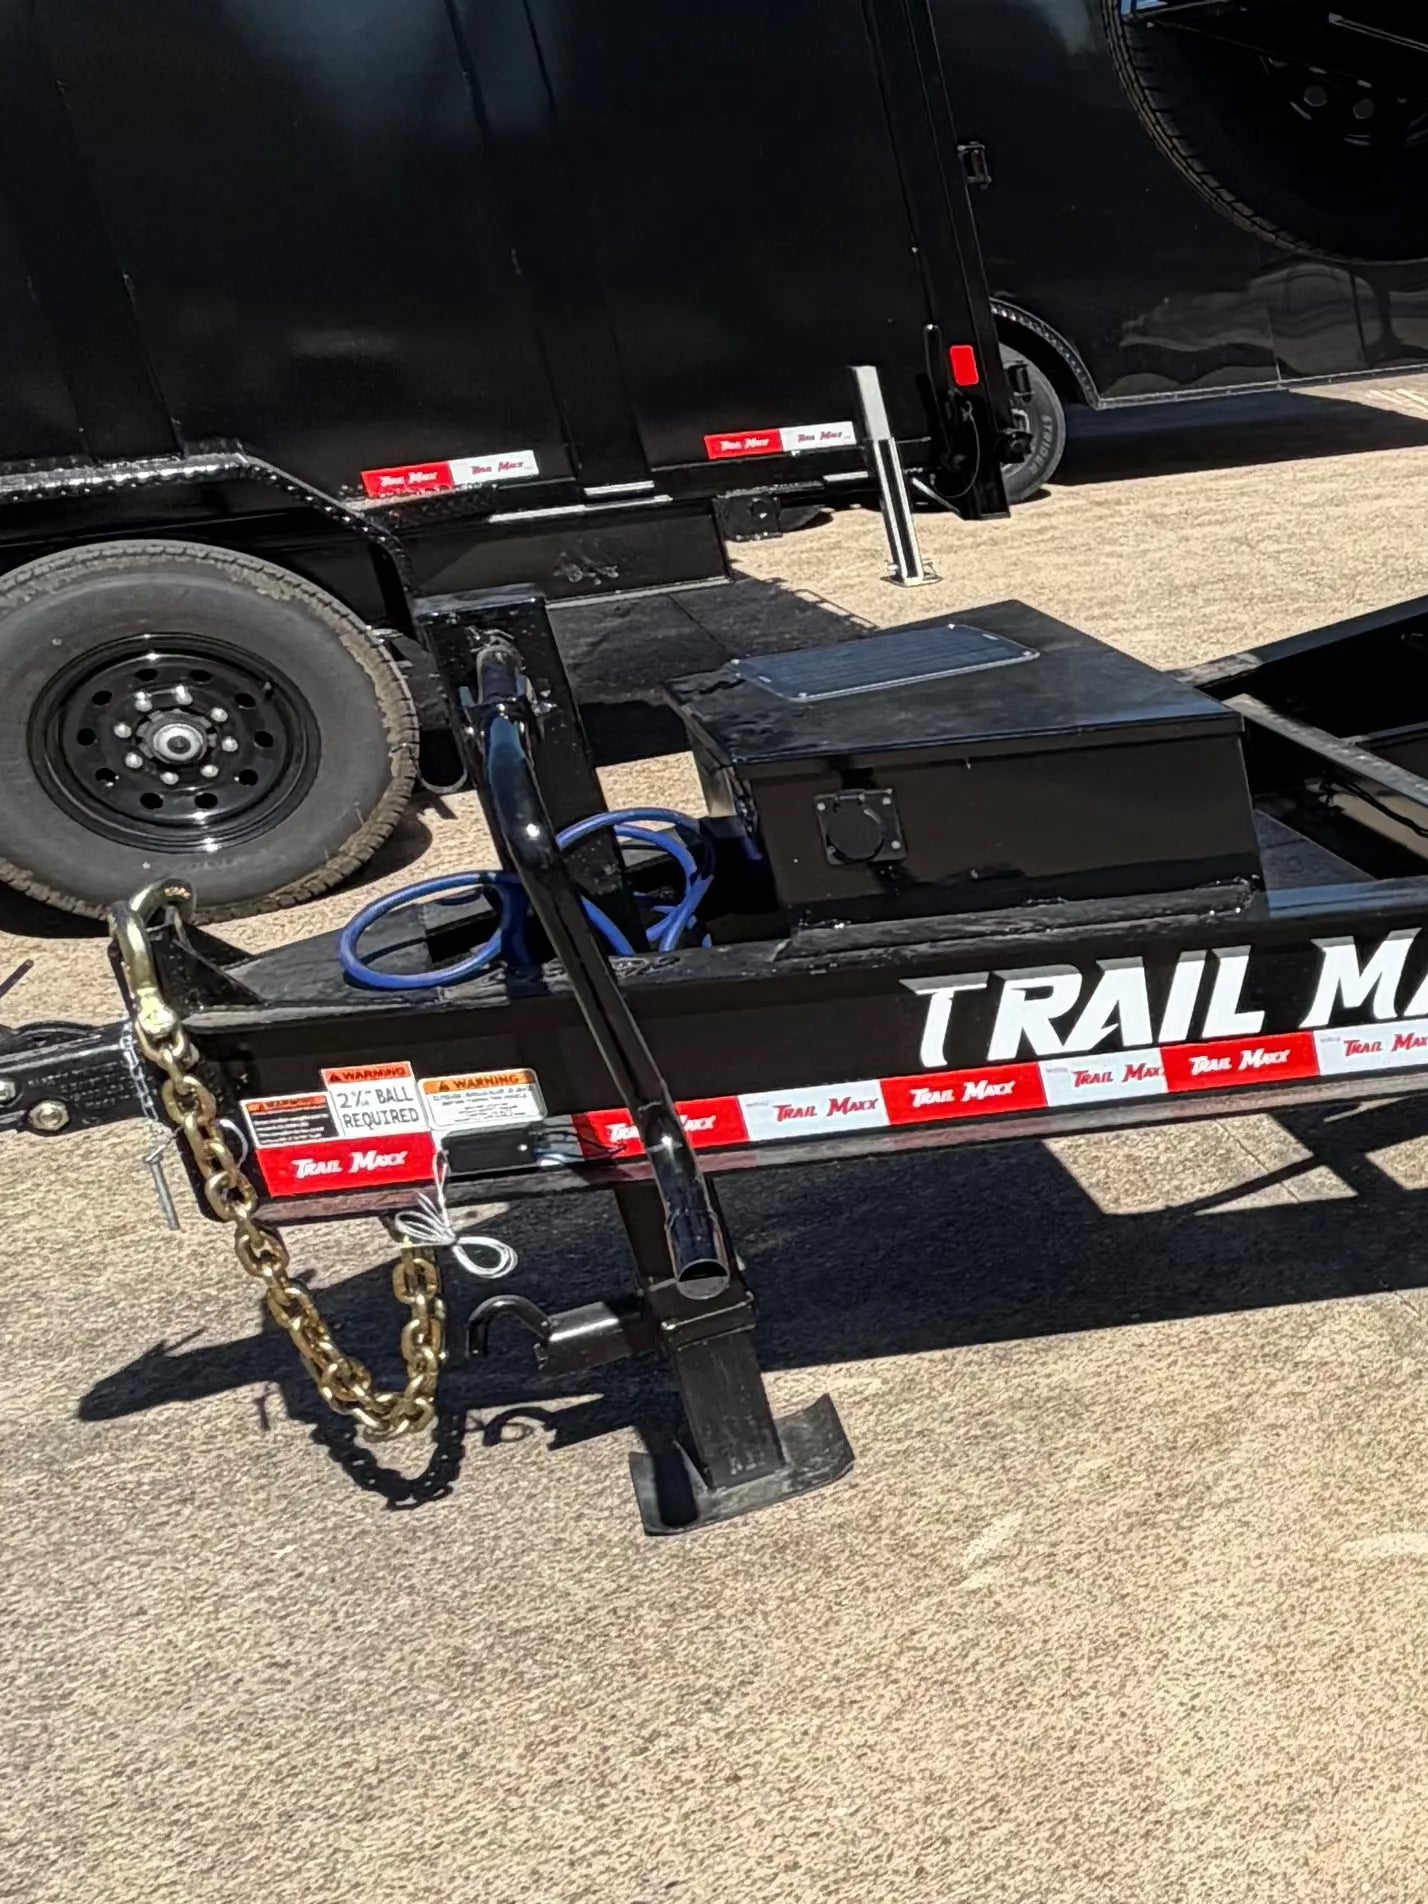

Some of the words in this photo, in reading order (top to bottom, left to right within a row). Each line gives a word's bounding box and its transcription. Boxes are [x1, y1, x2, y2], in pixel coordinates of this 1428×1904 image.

[900, 945, 1265, 1068] TRAIL
[375, 1086, 414, 1104] BALL
[342, 1107, 420, 1130] REQUIRED
